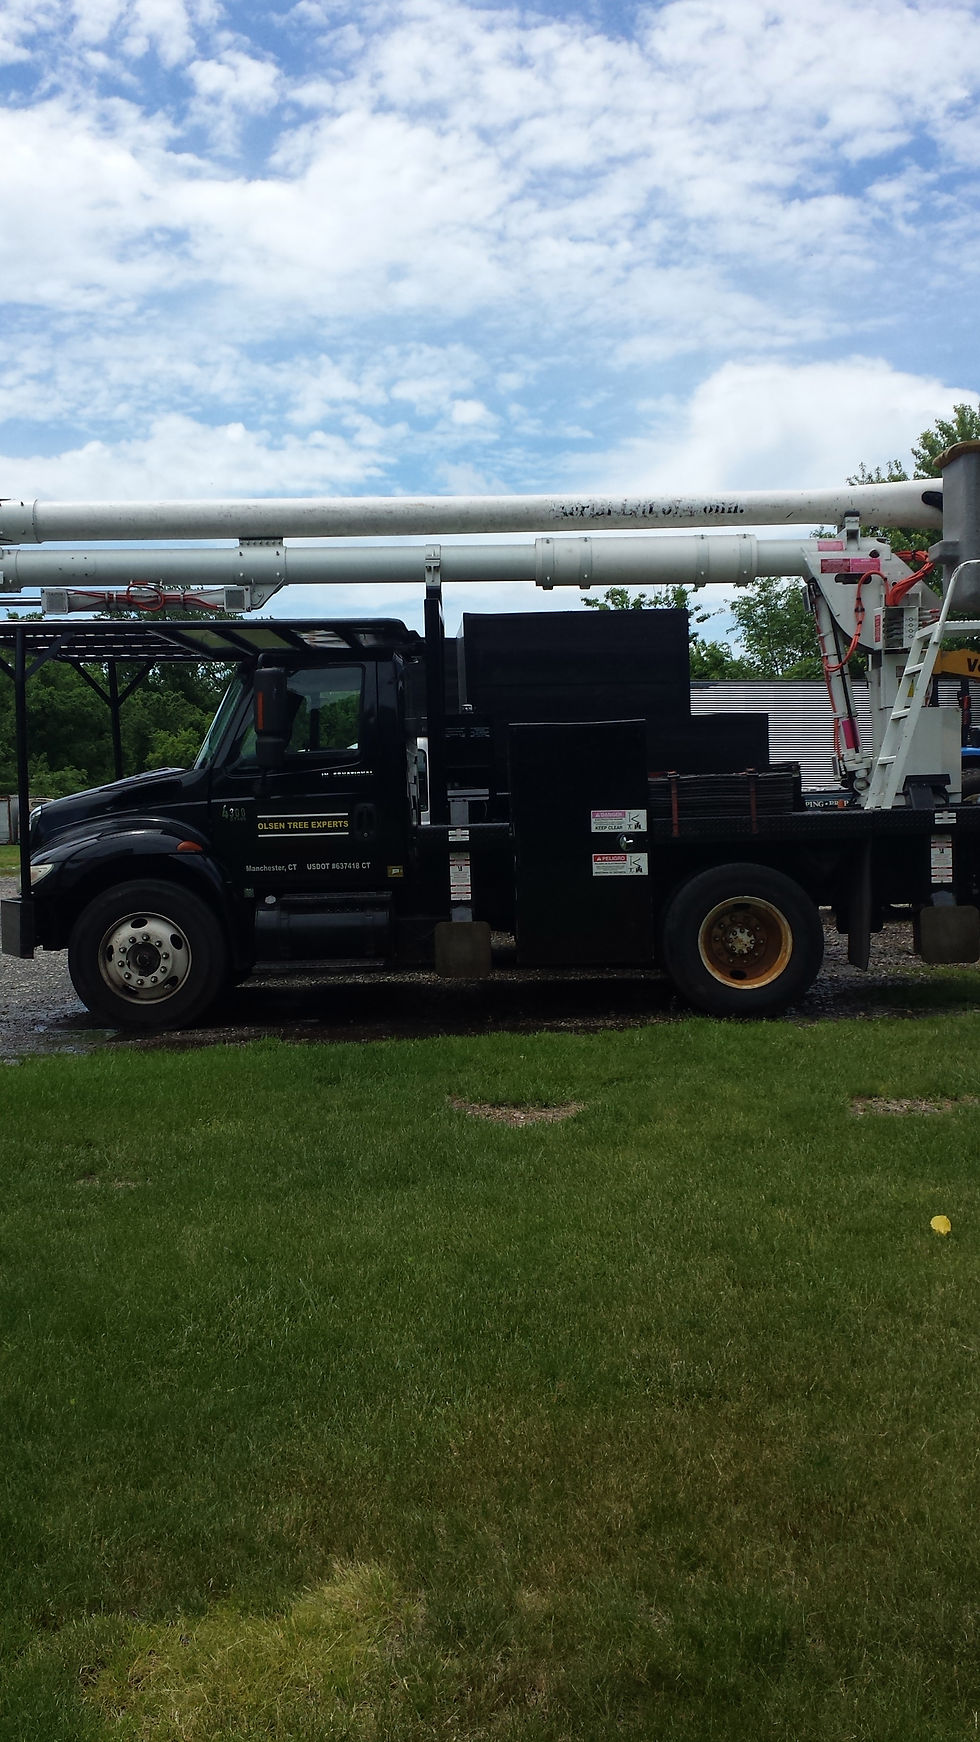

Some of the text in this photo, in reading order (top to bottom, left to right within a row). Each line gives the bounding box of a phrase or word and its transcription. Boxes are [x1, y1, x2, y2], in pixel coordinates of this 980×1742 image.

[967, 651, 980, 672] V
[221, 804, 246, 817] 4300
[257, 820, 349, 830] OLSEN TREE EXPERTS
[245, 861, 371, 872] Manchester, CT USDOT #637418 CT
